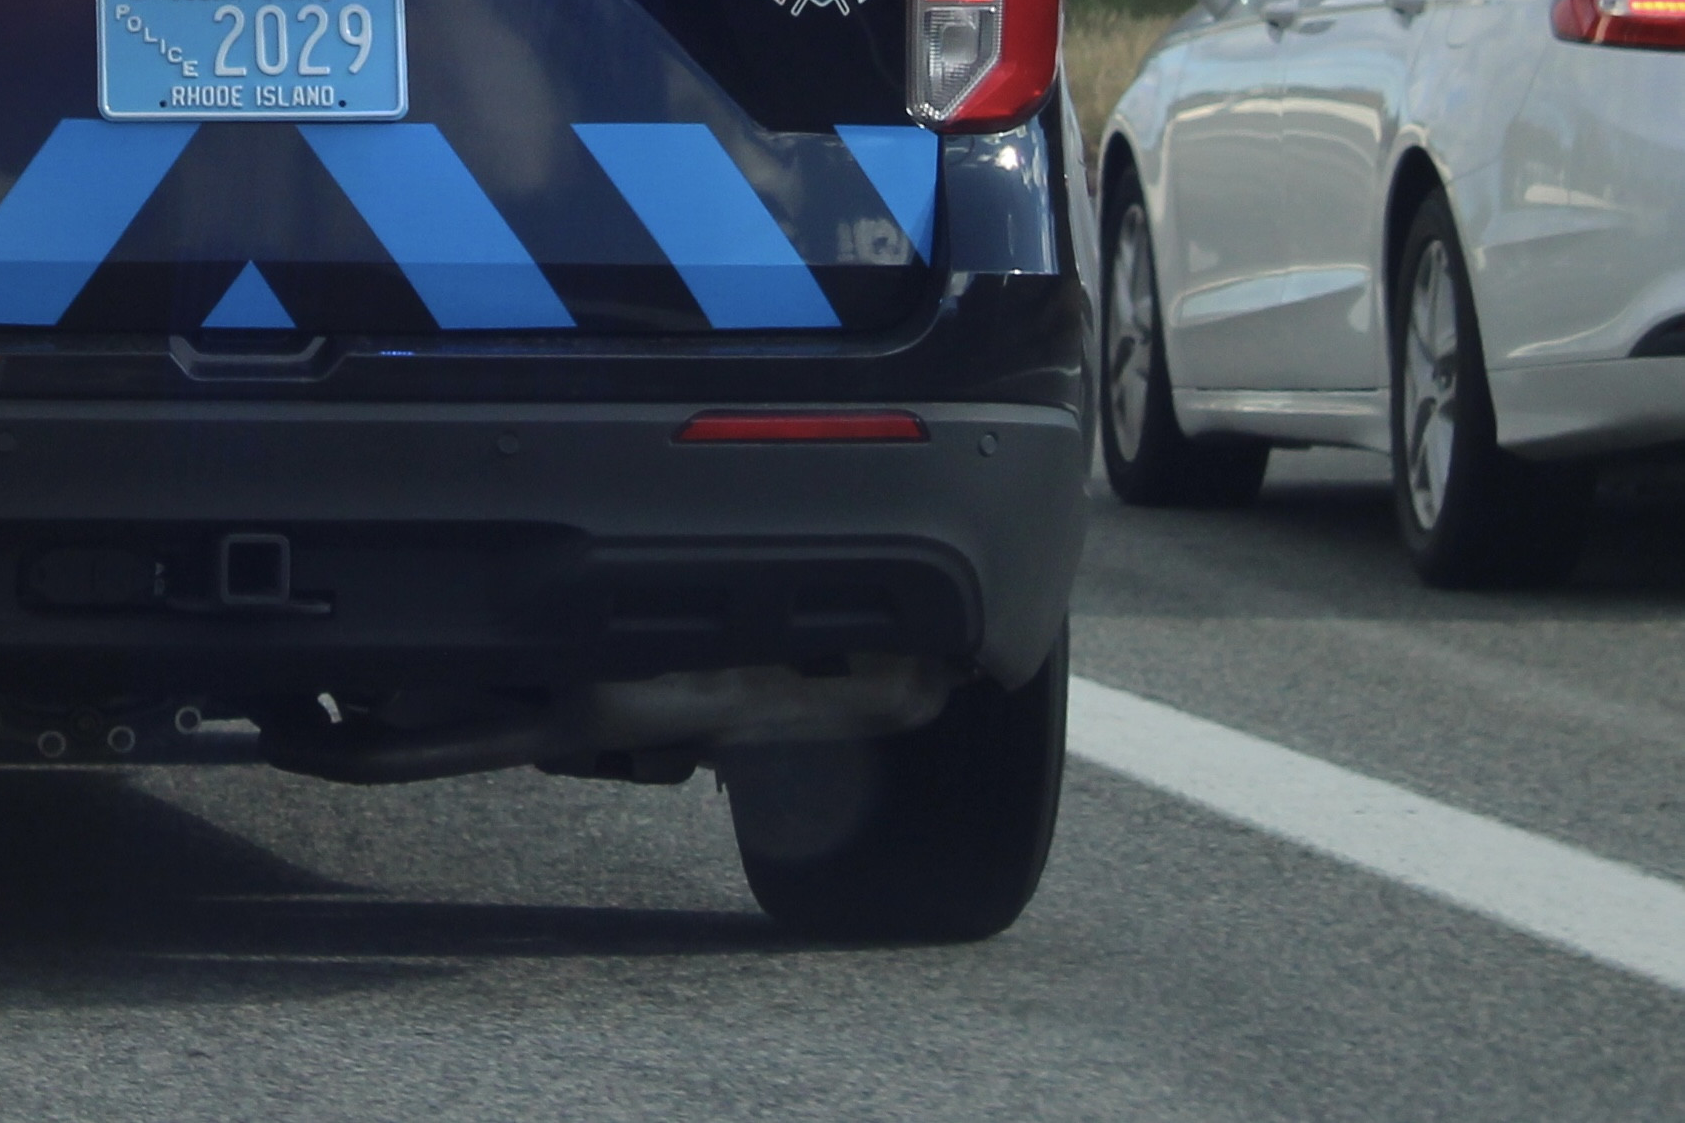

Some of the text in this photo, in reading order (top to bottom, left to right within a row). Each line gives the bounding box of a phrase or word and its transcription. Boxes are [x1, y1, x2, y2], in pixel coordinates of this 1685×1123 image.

[116, 4, 199, 77] POLICE
[214, 4, 373, 77] 2029
[171, 85, 334, 107] RHODE ISLAND
